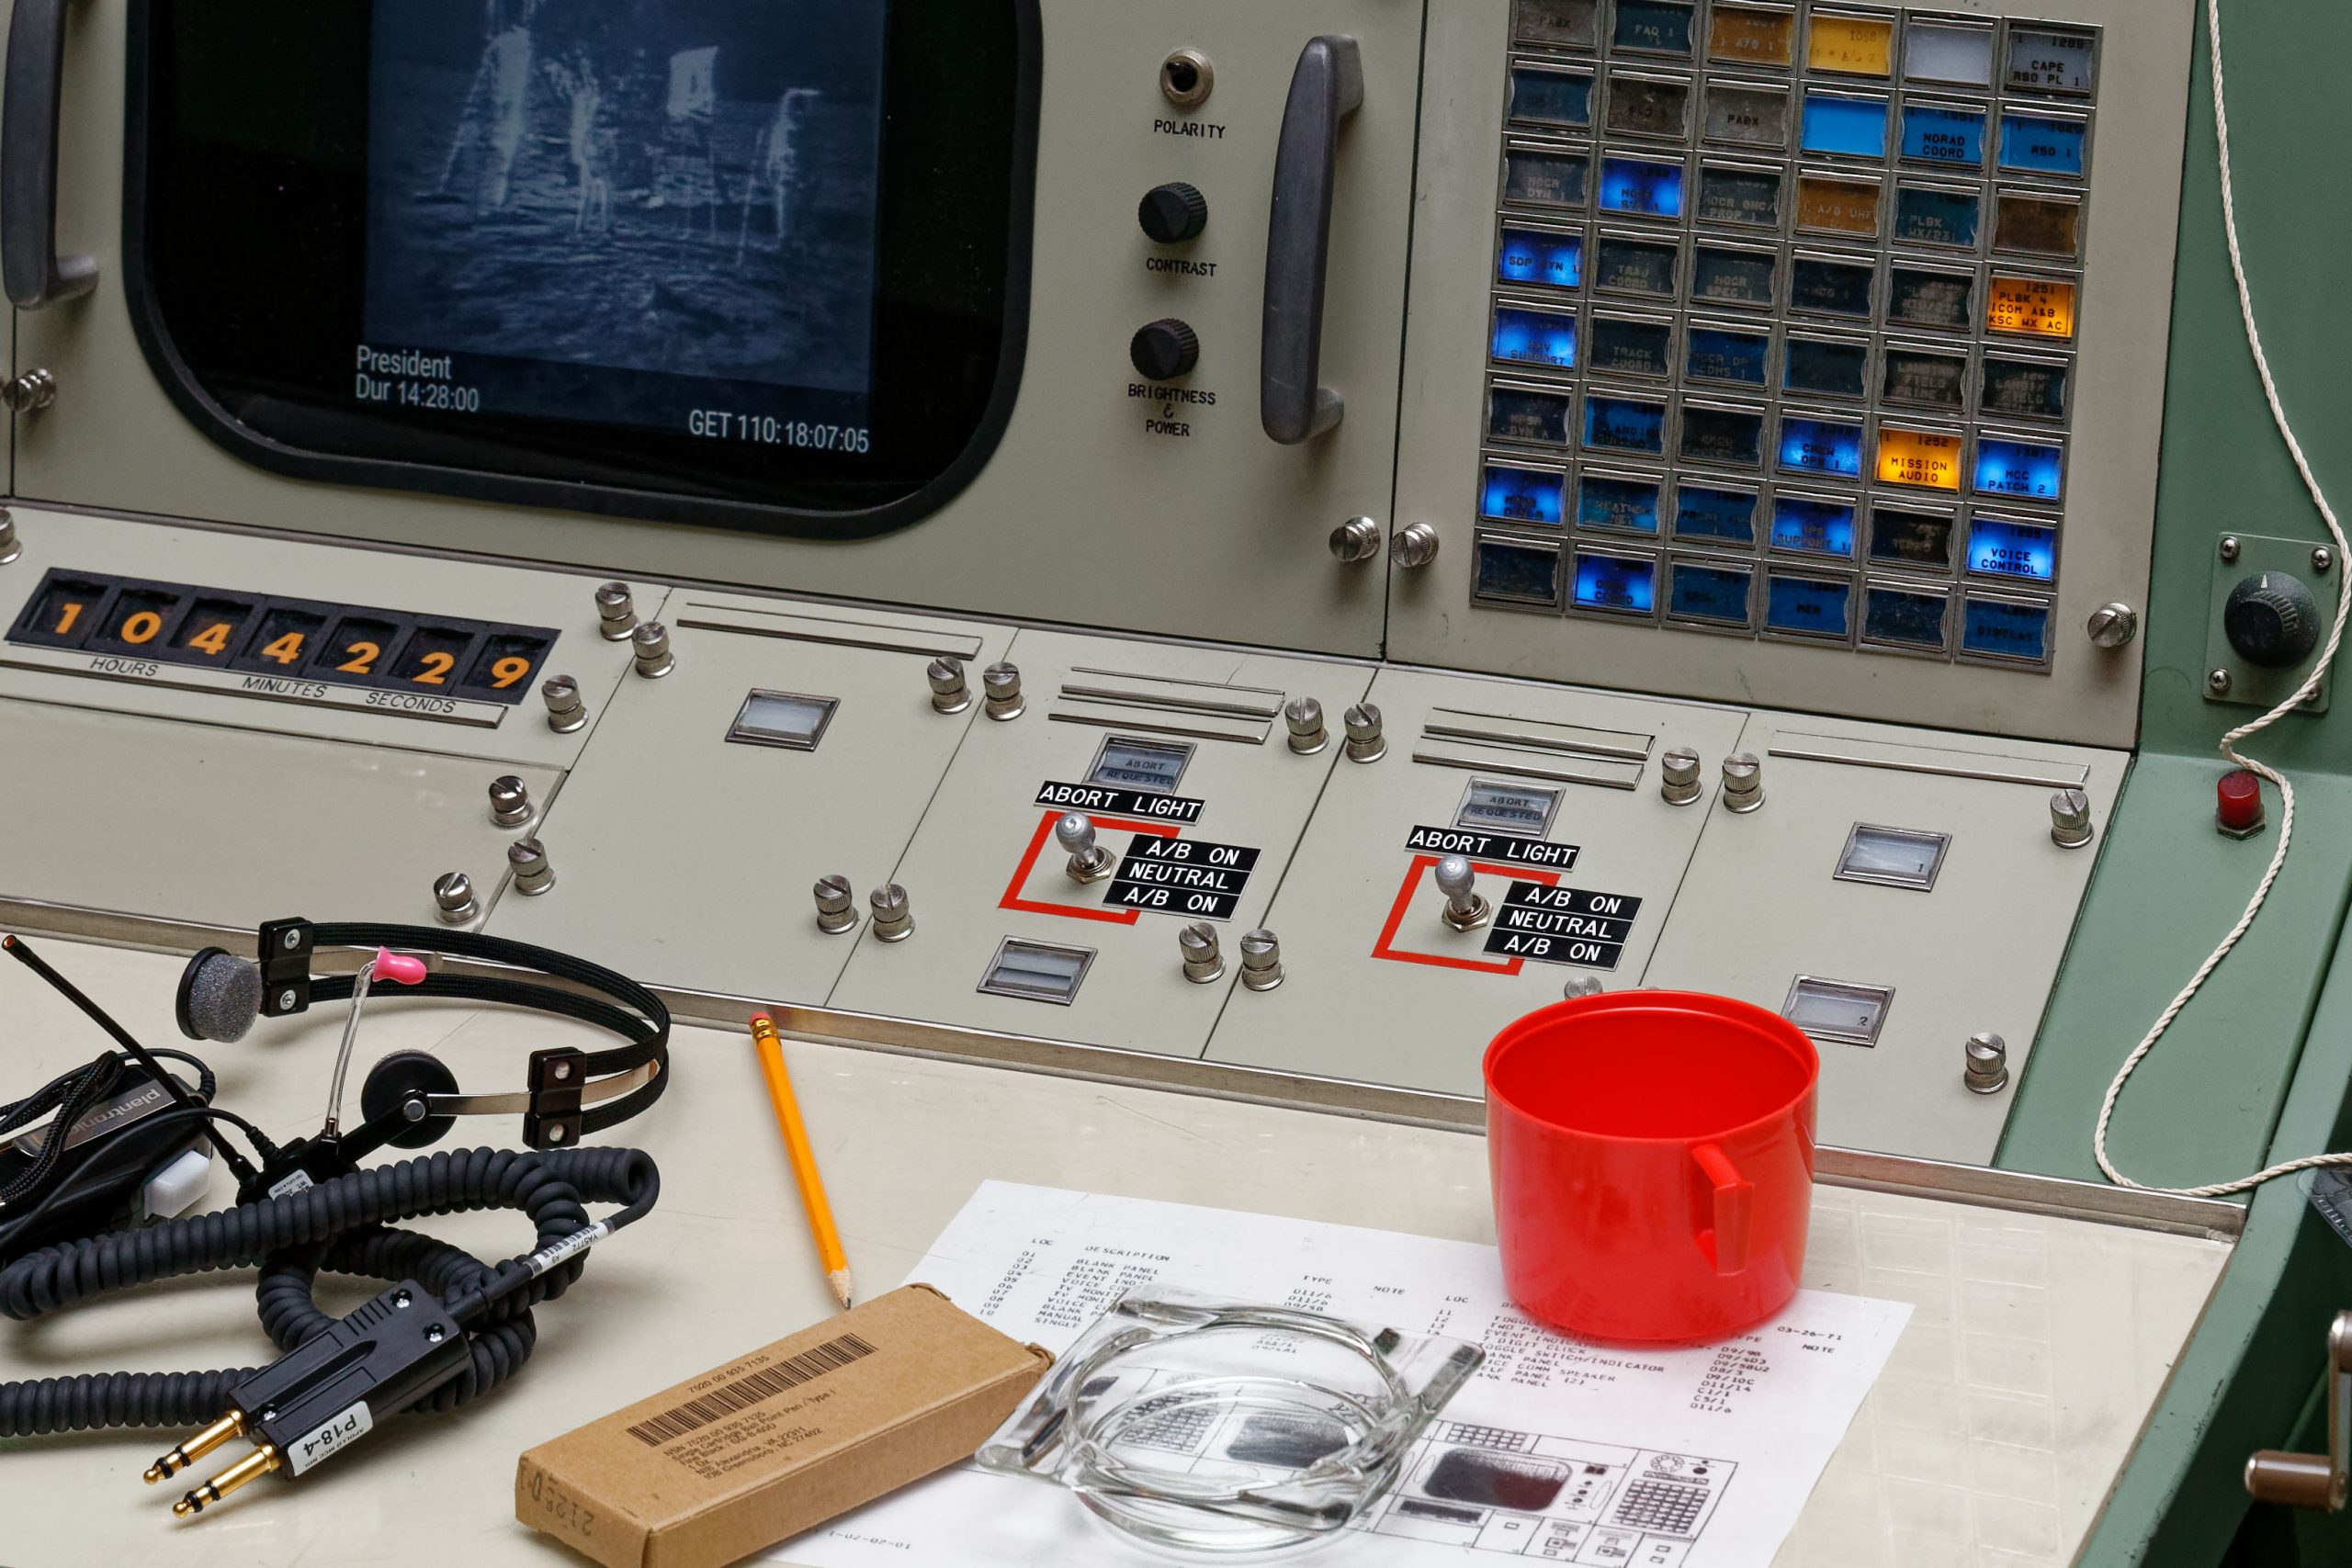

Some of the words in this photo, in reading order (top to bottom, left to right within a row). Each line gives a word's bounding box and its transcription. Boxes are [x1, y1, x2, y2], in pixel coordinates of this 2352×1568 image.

[2030, 60, 2065, 73] CAPE
[2046, 73, 2064, 85] PL
[1154, 119, 1226, 139] POLARITY
[1922, 132, 1966, 147] NORAD
[1922, 144, 1965, 159] COORD
[1146, 257, 1217, 277] CONTRAST
[1998, 290, 2031, 305] PLBK
[2039, 293, 2048, 306] 4
[1988, 314, 2013, 326] KSC
[2021, 317, 2038, 330] WX
[2046, 319, 2063, 332] AC
[356, 344, 451, 381] President
[356, 374, 390, 401] Dur
[397, 379, 479, 412] 14:28:00
[1127, 383, 1216, 405] BRIGHTNESS
[688, 409, 732, 439] GET
[737, 414, 869, 454] 110:18:07:05
[1146, 419, 1190, 437] POWER
[1891, 457, 1948, 471] MISSION
[1898, 469, 1939, 483] AUDIO
[1987, 480, 2030, 492] PATCH
[2037, 483, 2046, 494] 2
[1991, 548, 2031, 561] VOICE
[1982, 558, 2039, 575] CONTROL
[89, 656, 159, 678] HOURS
[242, 676, 328, 699] MINUTES
[365, 692, 457, 714] SECONDS
[1125, 759, 1166, 772] ABORT
[1038, 784, 1119, 809] ABORT
[1132, 795, 1202, 818] LIGHT
[1489, 795, 1530, 807] ABORT
[1470, 807, 1542, 821] REQUESTED
[1146, 840, 1193, 860] A/B
[1208, 848, 1240, 866] ON
[1408, 829, 1491, 853] ABORT
[1507, 841, 1577, 865] LIGHT
[1129, 862, 1229, 890] NEUTRAL
[1123, 887, 1170, 907] A/B
[1186, 895, 1218, 913] ON
[1525, 886, 1572, 907] A/B
[1589, 896, 1622, 914] ON
[1509, 909, 1612, 939] NEUTRAL
[1503, 935, 1551, 955] A/B
[1569, 942, 1601, 962] ON
[1857, 1015, 1869, 1026] 2
[70, 1087, 162, 1135] plantronic
[1016, 1257, 1033, 1265] 02
[1070, 1265, 1111, 1276] BLANK
[1118, 1271, 1154, 1281] PANEL
[1022, 1250, 1036, 1258] 01
[1076, 1258, 1116, 1269] BLANK
[1123, 1264, 1159, 1276] PANEL
[1061, 1278, 1102, 1288] VOICE
[1066, 1270, 1107, 1281] EVENT
[992, 1288, 1009, 1296] 07
[1046, 1297, 1087, 1308] VOICE
[1031, 1237, 1055, 1247] LOC
[1084, 1245, 1170, 1262] DESCRIPTION
[1303, 1274, 1333, 1285] TYPE
[1374, 1285, 1406, 1296] NOTE
[1445, 1295, 1469, 1303] LOC
[1802, 1343, 1836, 1354] NOTE
[983, 1302, 1000, 1310] 09
[1036, 1310, 1083, 1323] MANUAL
[1042, 1303, 1082, 1315] BLANK
[1034, 1317, 1080, 1329] SINGLE
[1489, 1322, 1514, 1331] TWO
[1485, 1329, 1525, 1339] EVENT
[1777, 1325, 1842, 1341] 03-26-71
[1498, 1337, 1538, 1348] DIGIT
[1546, 1345, 1587, 1355] CLOCK
[1523, 1356, 1561, 1367] PANEL
[1535, 1350, 1665, 1373] SWITCH/INDICATOR
[712, 1373, 726, 1383] 00
[1515, 1370, 1552, 1381] PANEL
[1517, 1362, 1551, 1372] COMM
[1559, 1368, 1616, 1382] SPEAKER
[1510, 1377, 1548, 1388] PANEL
[301, 1413, 360, 1458] P18-4
